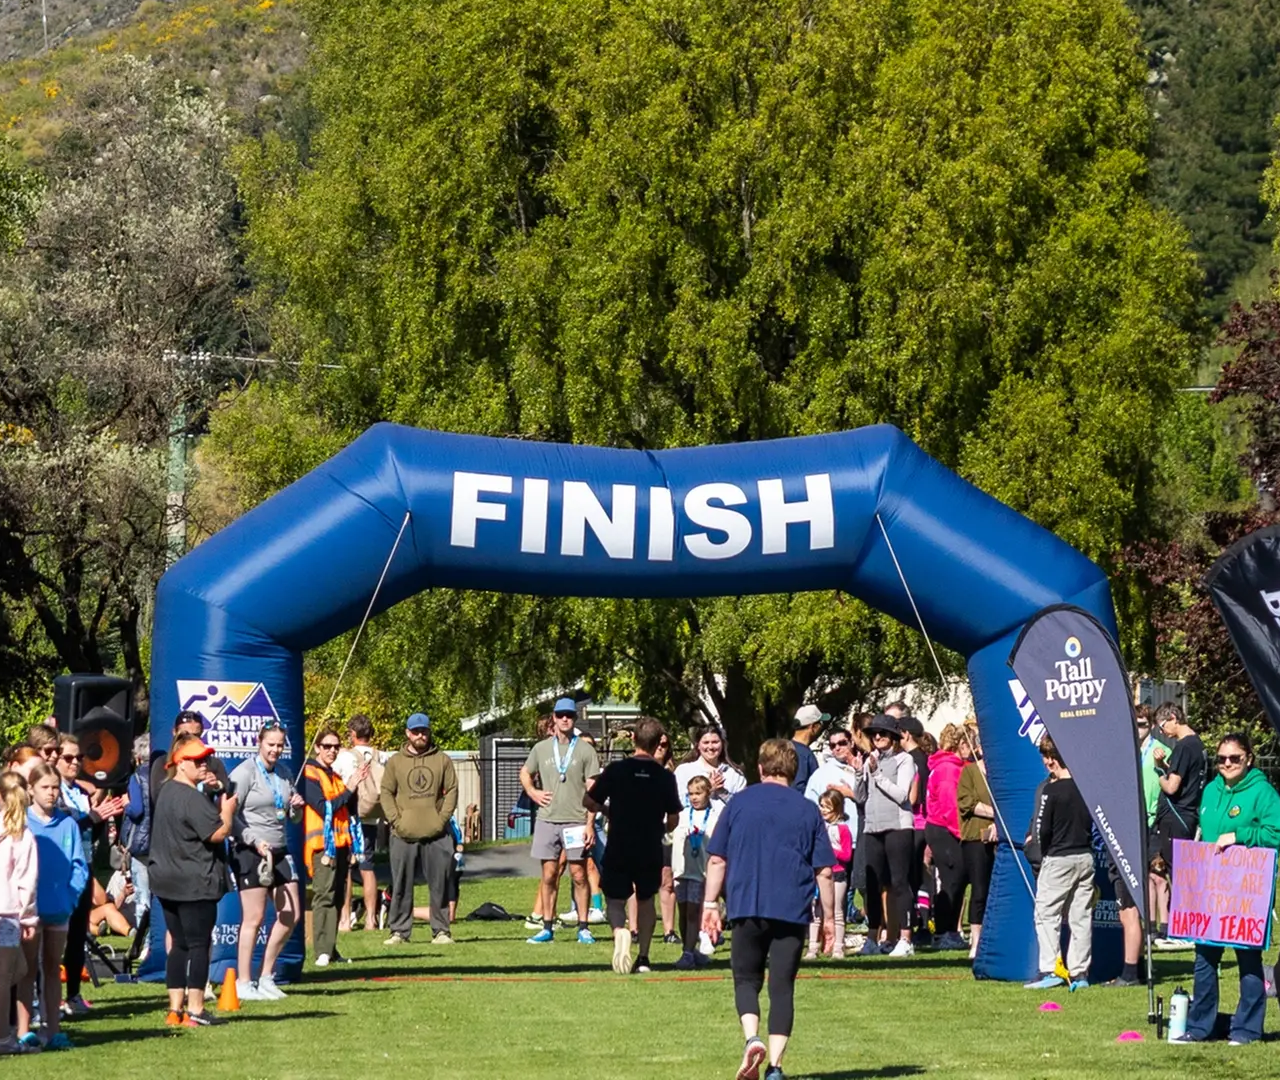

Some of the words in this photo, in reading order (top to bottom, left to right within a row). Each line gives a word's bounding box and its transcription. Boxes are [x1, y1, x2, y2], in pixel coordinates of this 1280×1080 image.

[450, 471, 835, 561] FINISH
[1055, 657, 1093, 682] Tall
[1045, 679, 1106, 706] Poppy
[1060, 710, 1075, 718] REAL
[1076, 708, 1096, 718] ESTATE
[1094, 805, 1140, 889] TALLPOPPY.CO.NZ
[1240, 873, 1265, 895] ARE
[1172, 910, 1211, 936] HAPPY
[1220, 916, 1264, 943] TEARS
